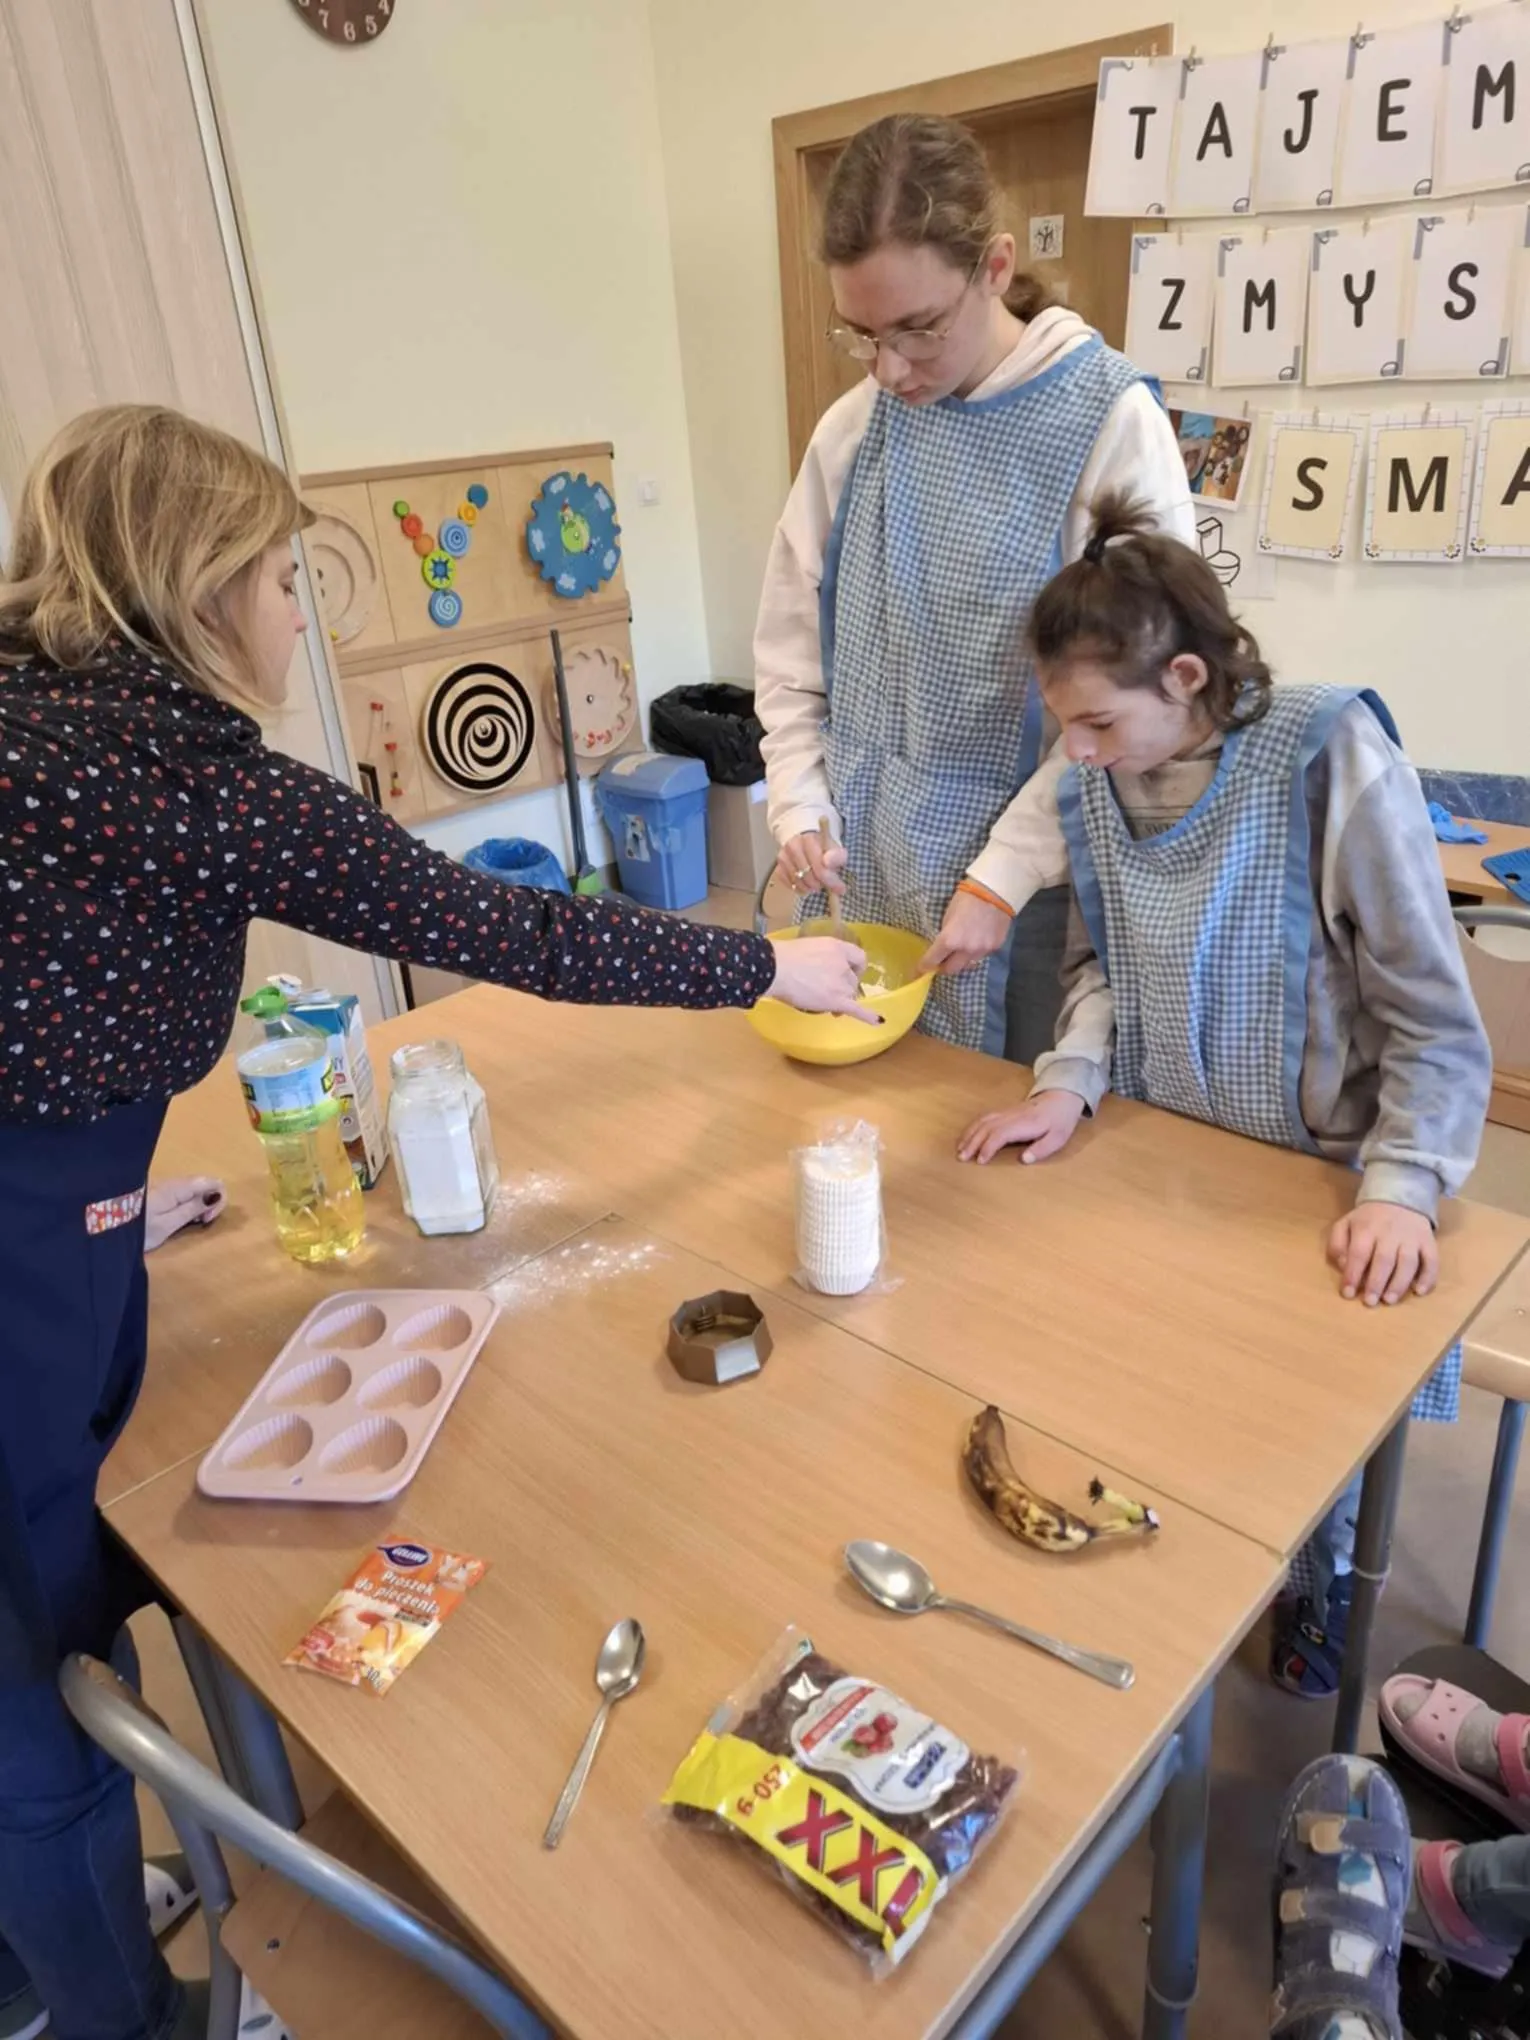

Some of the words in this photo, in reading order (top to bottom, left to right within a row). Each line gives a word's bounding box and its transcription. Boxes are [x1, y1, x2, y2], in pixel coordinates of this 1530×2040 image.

[318, 8, 330, 29] 7
[365, 14, 378, 35] 5
[343, 20, 356, 42] 6
